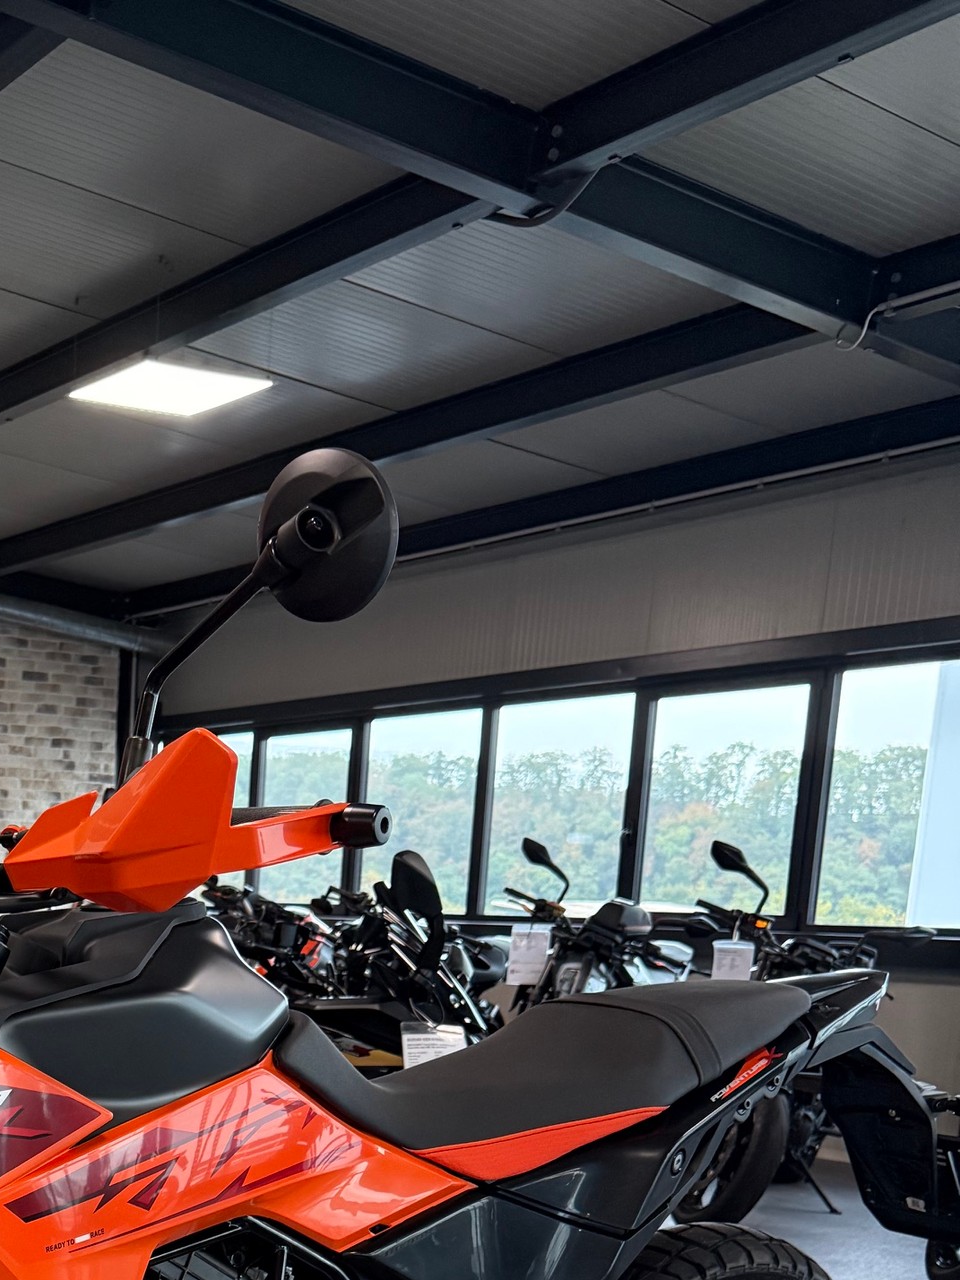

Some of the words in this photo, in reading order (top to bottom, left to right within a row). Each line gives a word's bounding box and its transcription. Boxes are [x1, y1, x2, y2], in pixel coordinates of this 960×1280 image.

[45, 1240, 67, 1254] READY
[66, 1238, 76, 1247] TO
[89, 1228, 105, 1239] RACE
